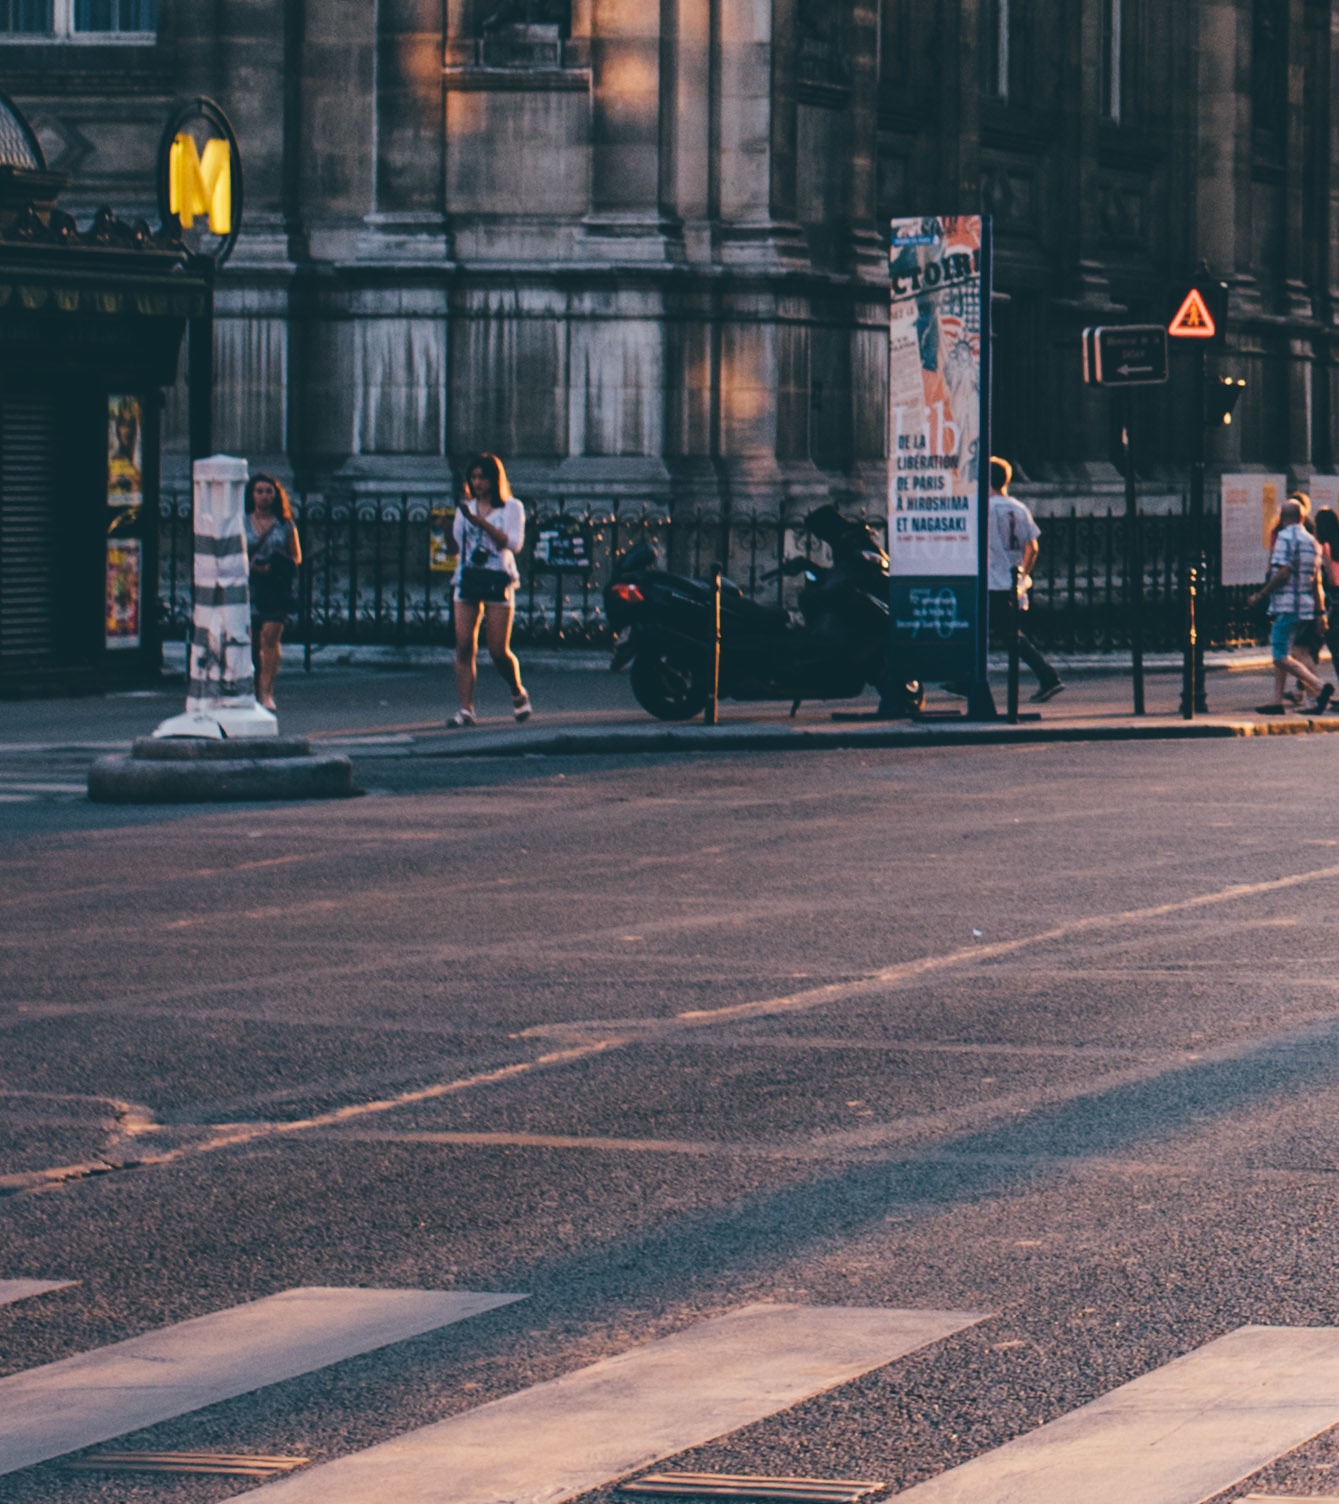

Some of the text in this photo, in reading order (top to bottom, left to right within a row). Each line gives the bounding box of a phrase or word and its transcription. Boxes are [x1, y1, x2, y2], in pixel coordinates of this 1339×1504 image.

[169, 131, 231, 235] M
[897, 434, 926, 450] DE LA
[896, 475, 945, 491] DE PARIS
[907, 495, 969, 511] HIROSHIMA
[896, 516, 967, 532] ET NAGASAKI
